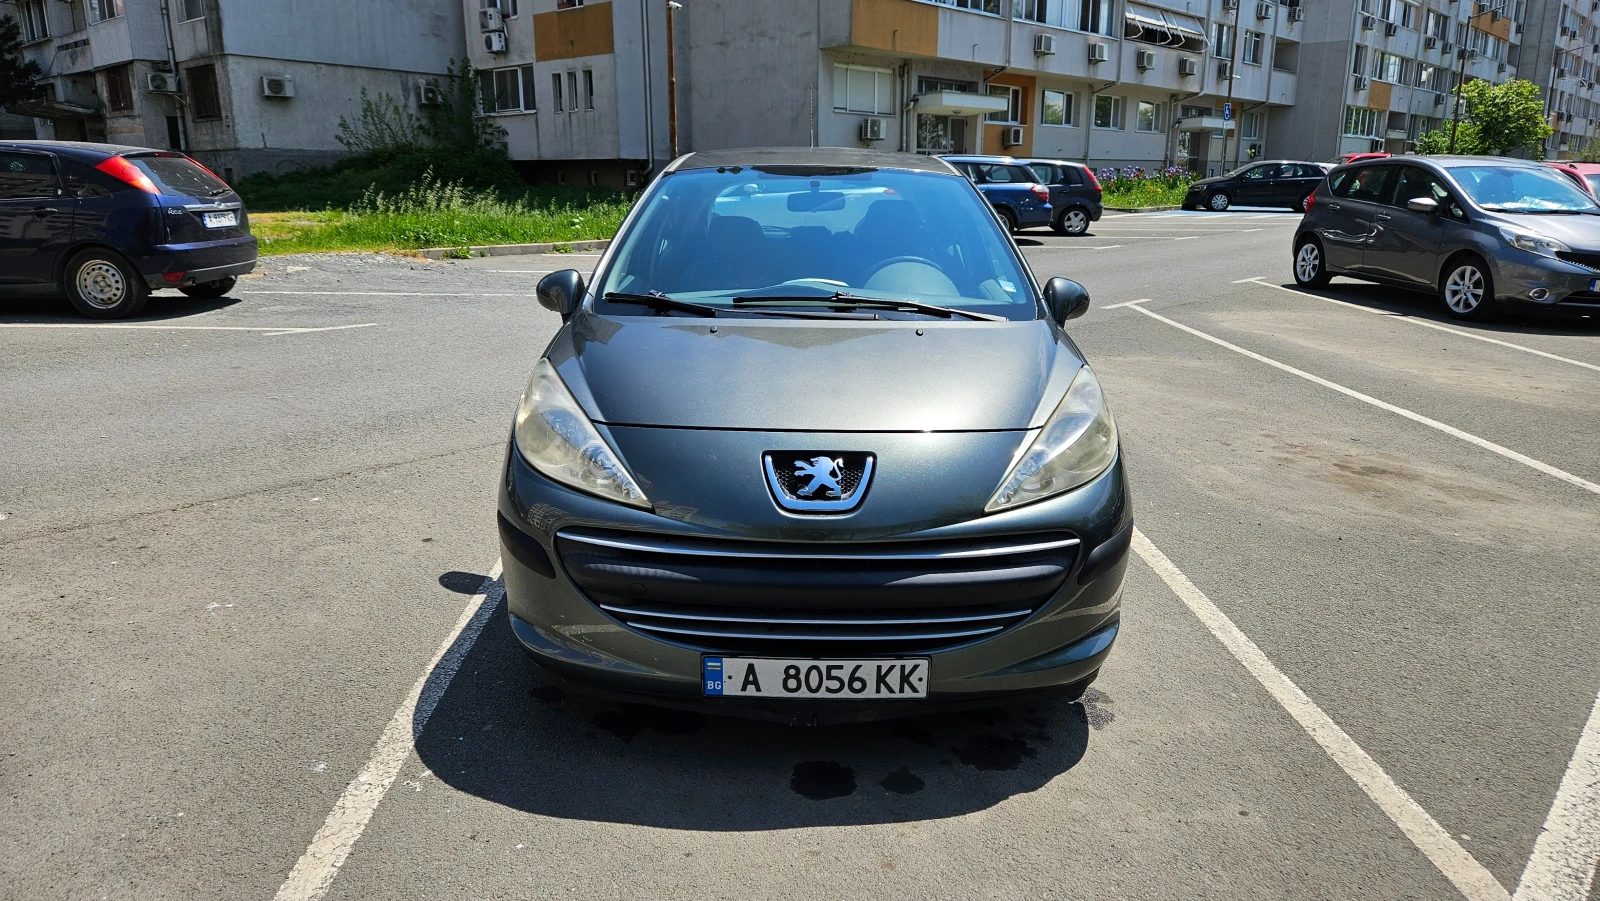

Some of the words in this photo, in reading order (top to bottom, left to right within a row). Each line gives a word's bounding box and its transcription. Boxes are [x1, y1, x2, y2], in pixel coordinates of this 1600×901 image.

[707, 681, 722, 690] BG
[740, 663, 762, 692] A
[782, 664, 867, 694] 8056
[875, 664, 921, 694] KK
